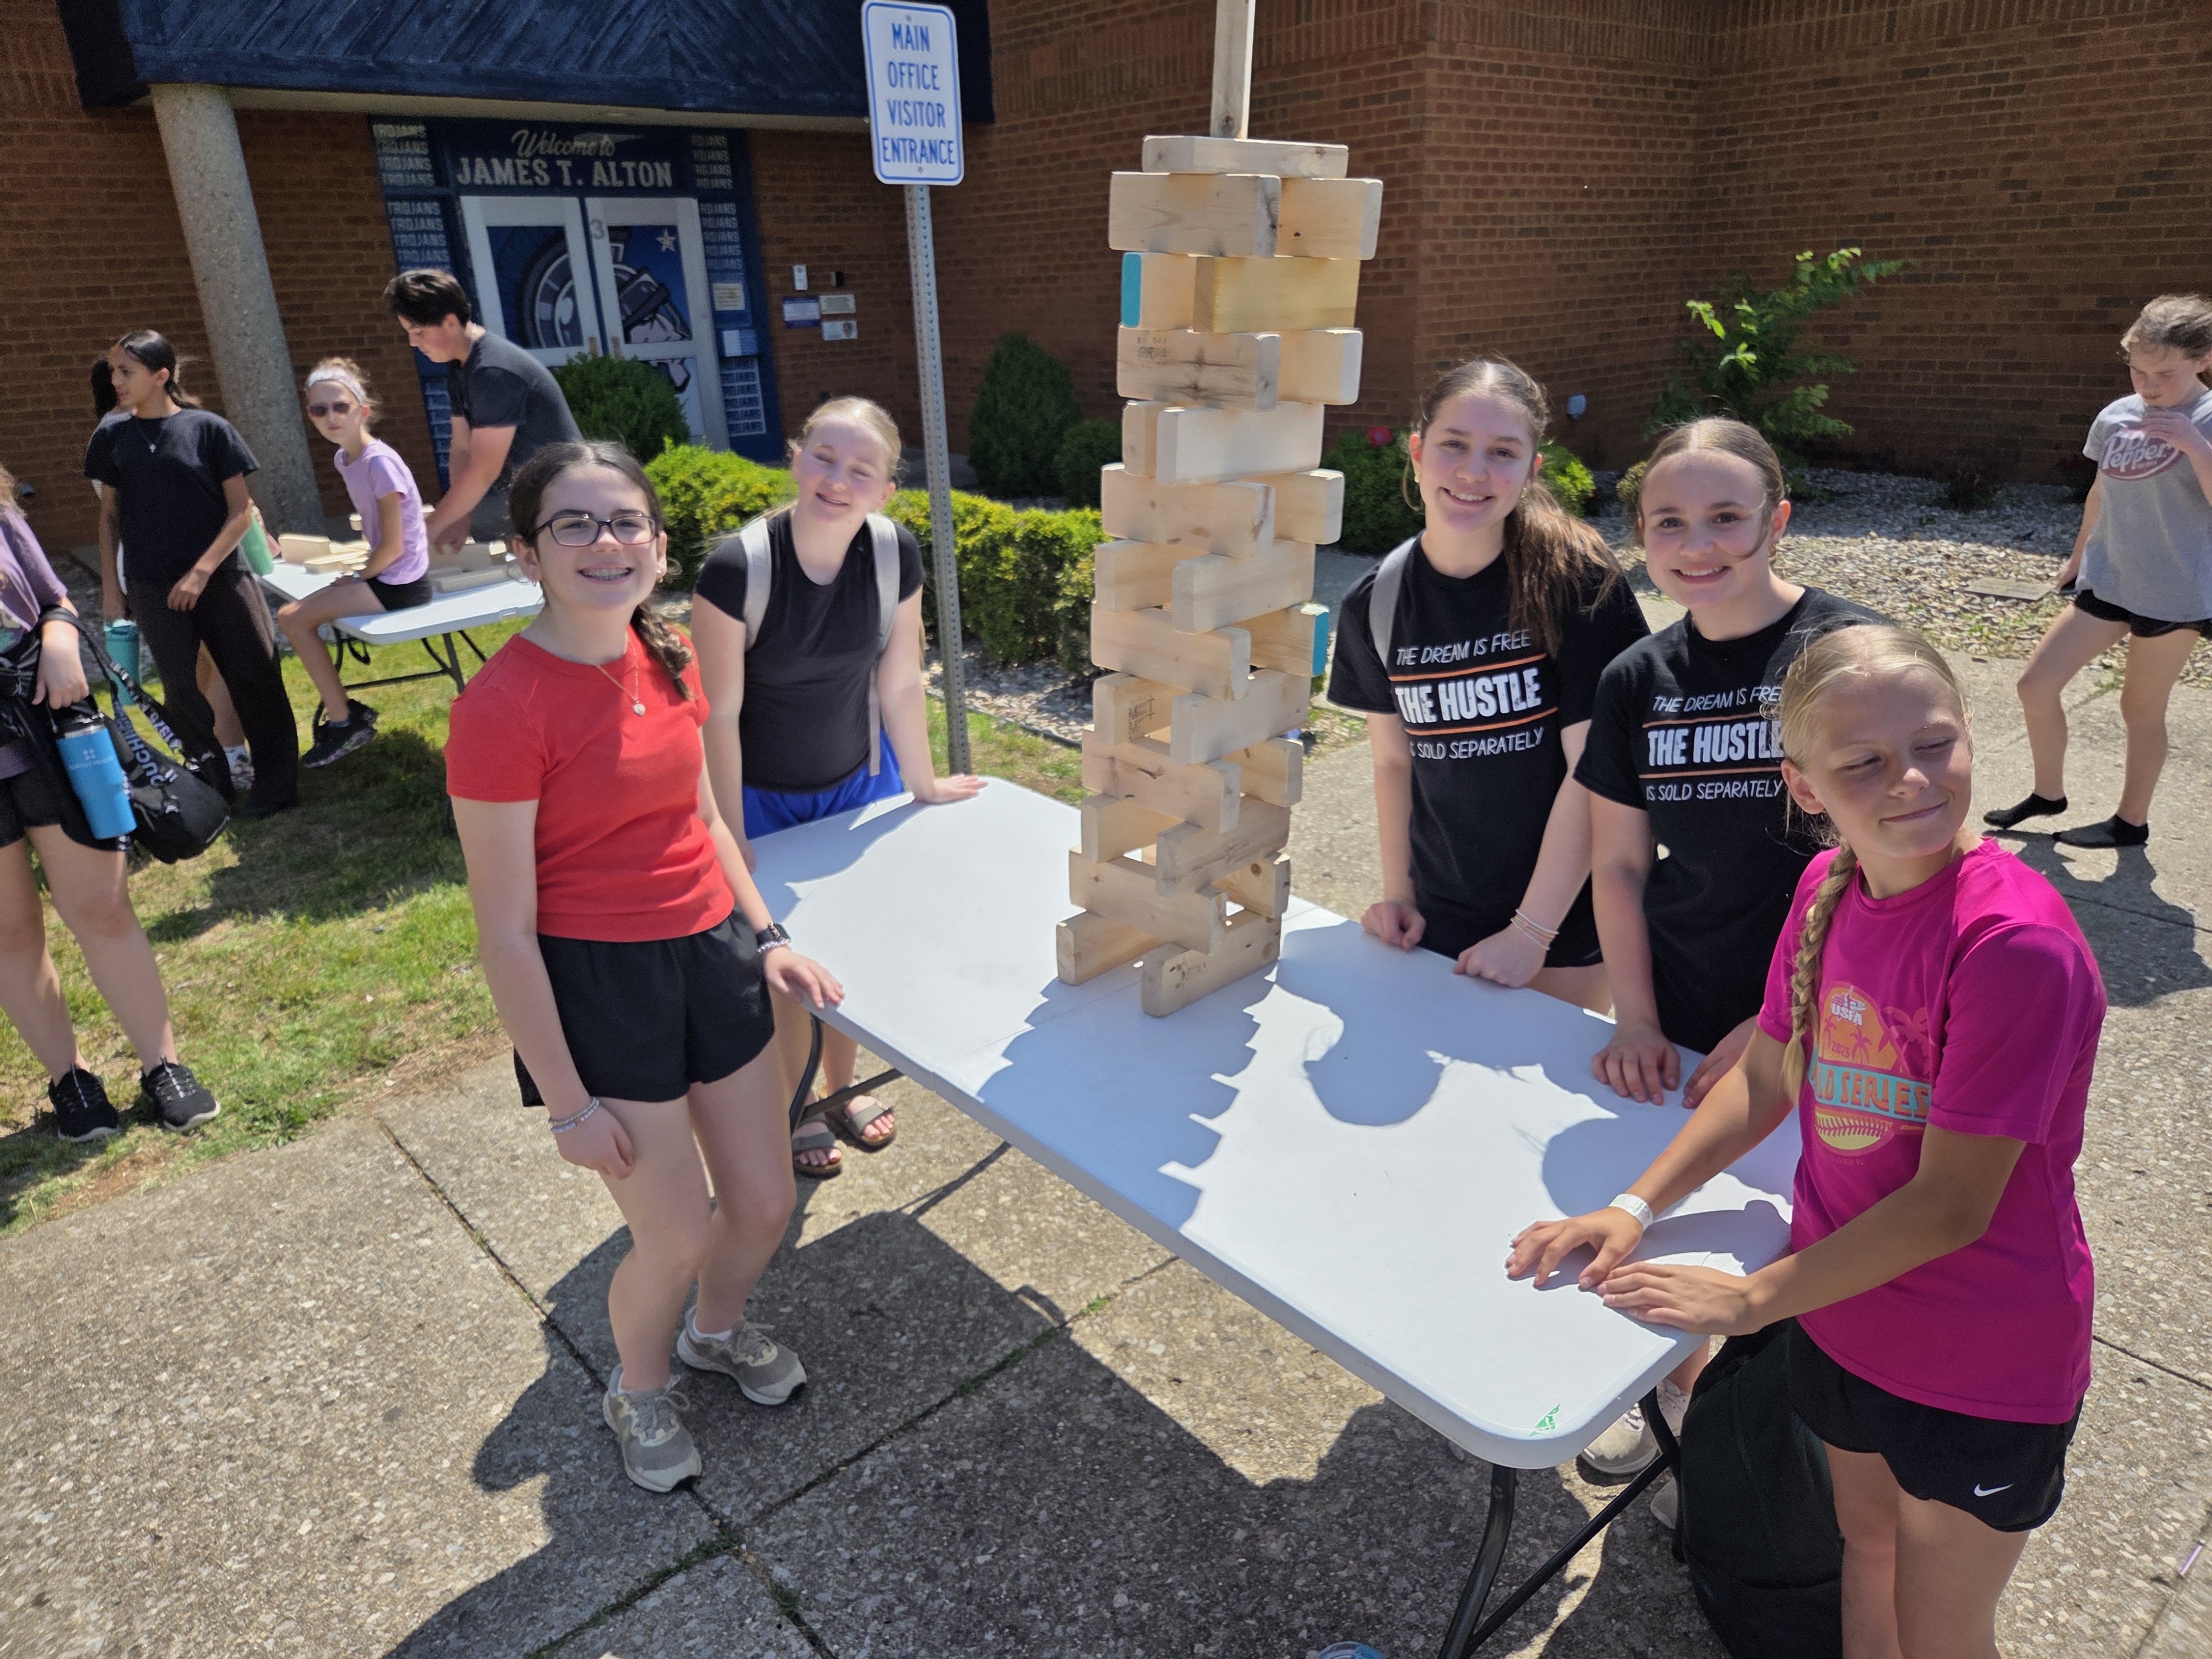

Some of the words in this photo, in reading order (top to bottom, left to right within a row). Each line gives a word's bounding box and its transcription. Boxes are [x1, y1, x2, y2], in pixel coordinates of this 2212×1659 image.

[891, 23, 931, 53] MAIN
[888, 60, 940, 91] OFFICE
[887, 99, 946, 128] VISITOR
[511, 129, 597, 157] Welcome
[597, 134, 615, 157] to
[881, 137, 955, 165] ENTRANCE
[456, 157, 550, 186] JAMES
[556, 159, 583, 186] T.
[592, 160, 672, 187] ALTON
[589, 218, 605, 240] 3
[1396, 646, 1419, 665] THE
[1421, 640, 1470, 664] DREAM
[1473, 638, 1489, 656] IS
[1491, 629, 1533, 653] FREE
[1395, 685, 1437, 723] THE
[1438, 667, 1542, 721] HUSTLE
[1652, 696, 1683, 712] THE
[1683, 690, 1733, 712] DREAM
[1736, 688, 1747, 706] IS
[1417, 742, 1447, 759] SOLD
[1449, 726, 1545, 759] SEPARATELY
[1648, 729, 1690, 766] THE
[1646, 785, 1656, 801] IS
[1657, 784, 1693, 801] SOLD
[1696, 779, 1783, 800] SEPARATELY
